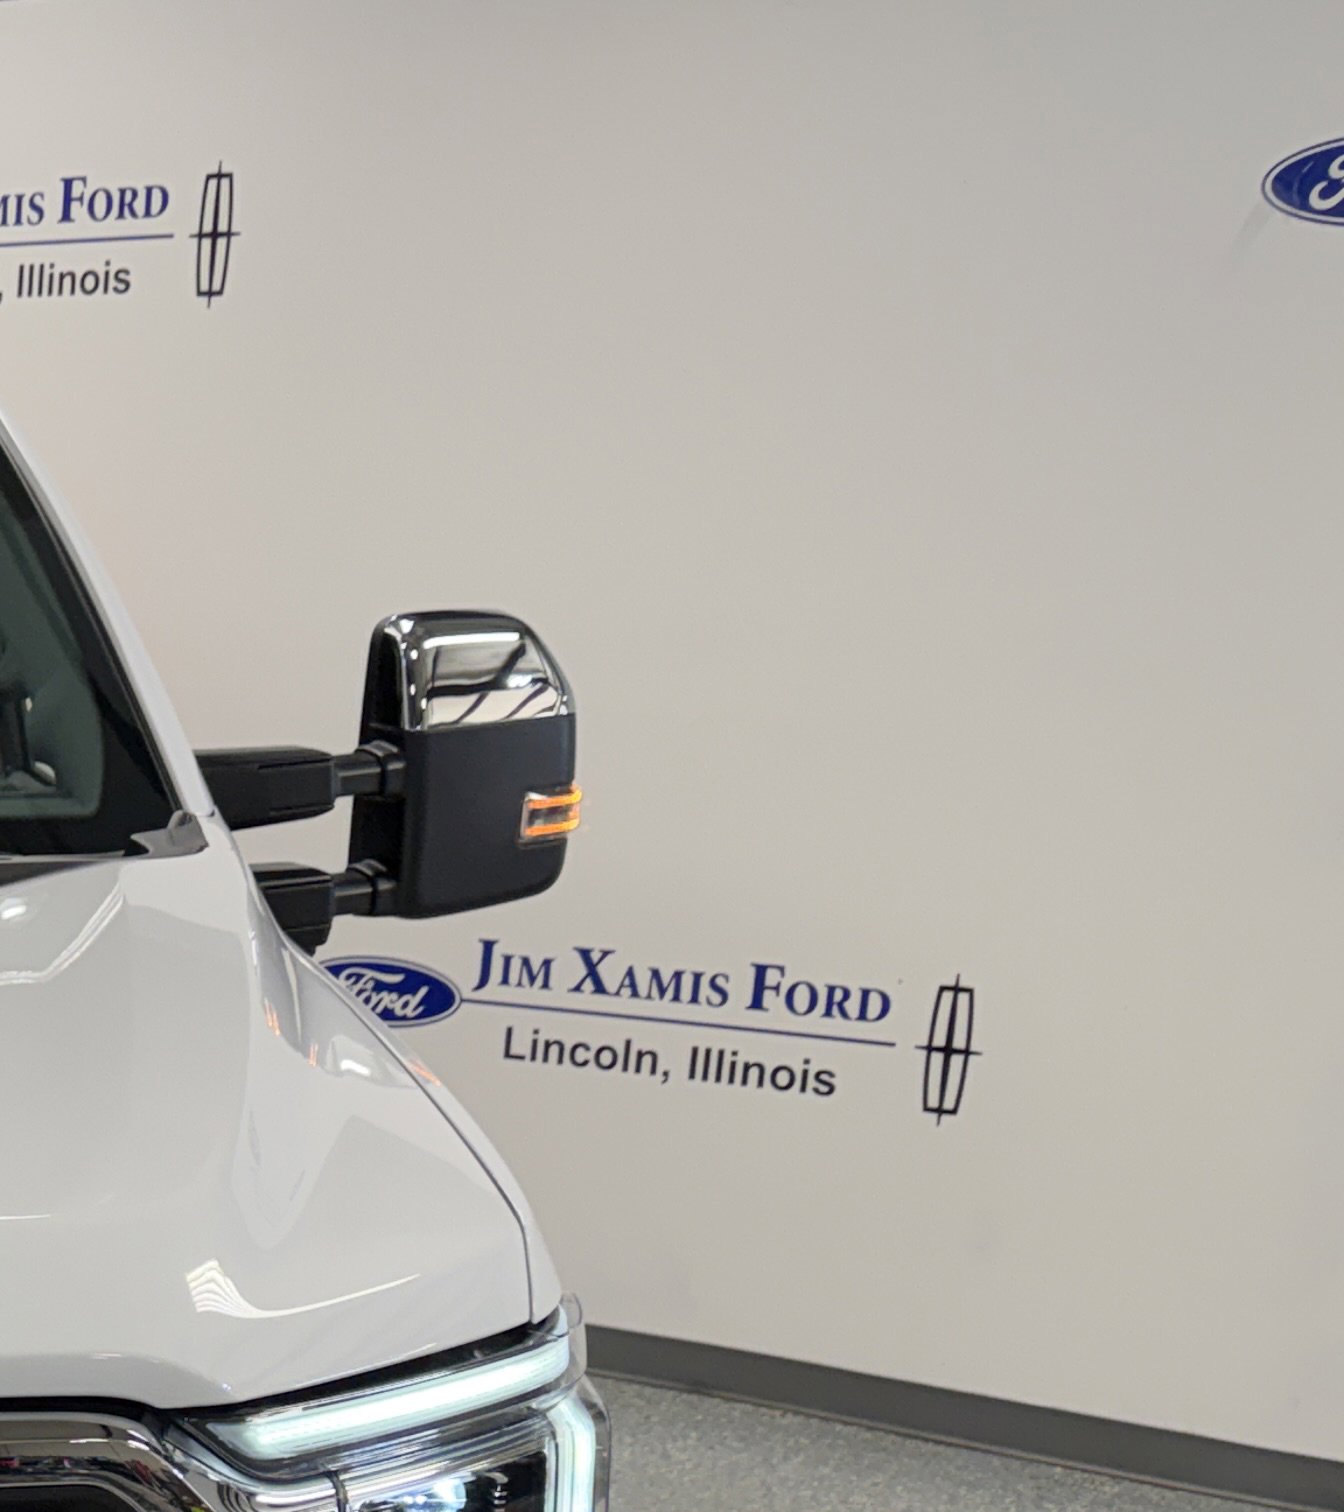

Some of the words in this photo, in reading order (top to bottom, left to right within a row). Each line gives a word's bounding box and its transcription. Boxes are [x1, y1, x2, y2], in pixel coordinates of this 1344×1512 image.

[57, 176, 170, 224] FORD
[17, 260, 132, 299] Illinois
[471, 938, 556, 993] JIM
[567, 946, 730, 1009] XAMIS
[744, 962, 892, 1024] FORD
[502, 1026, 671, 1085] Lincoln,
[687, 1046, 837, 1096] Illinois
